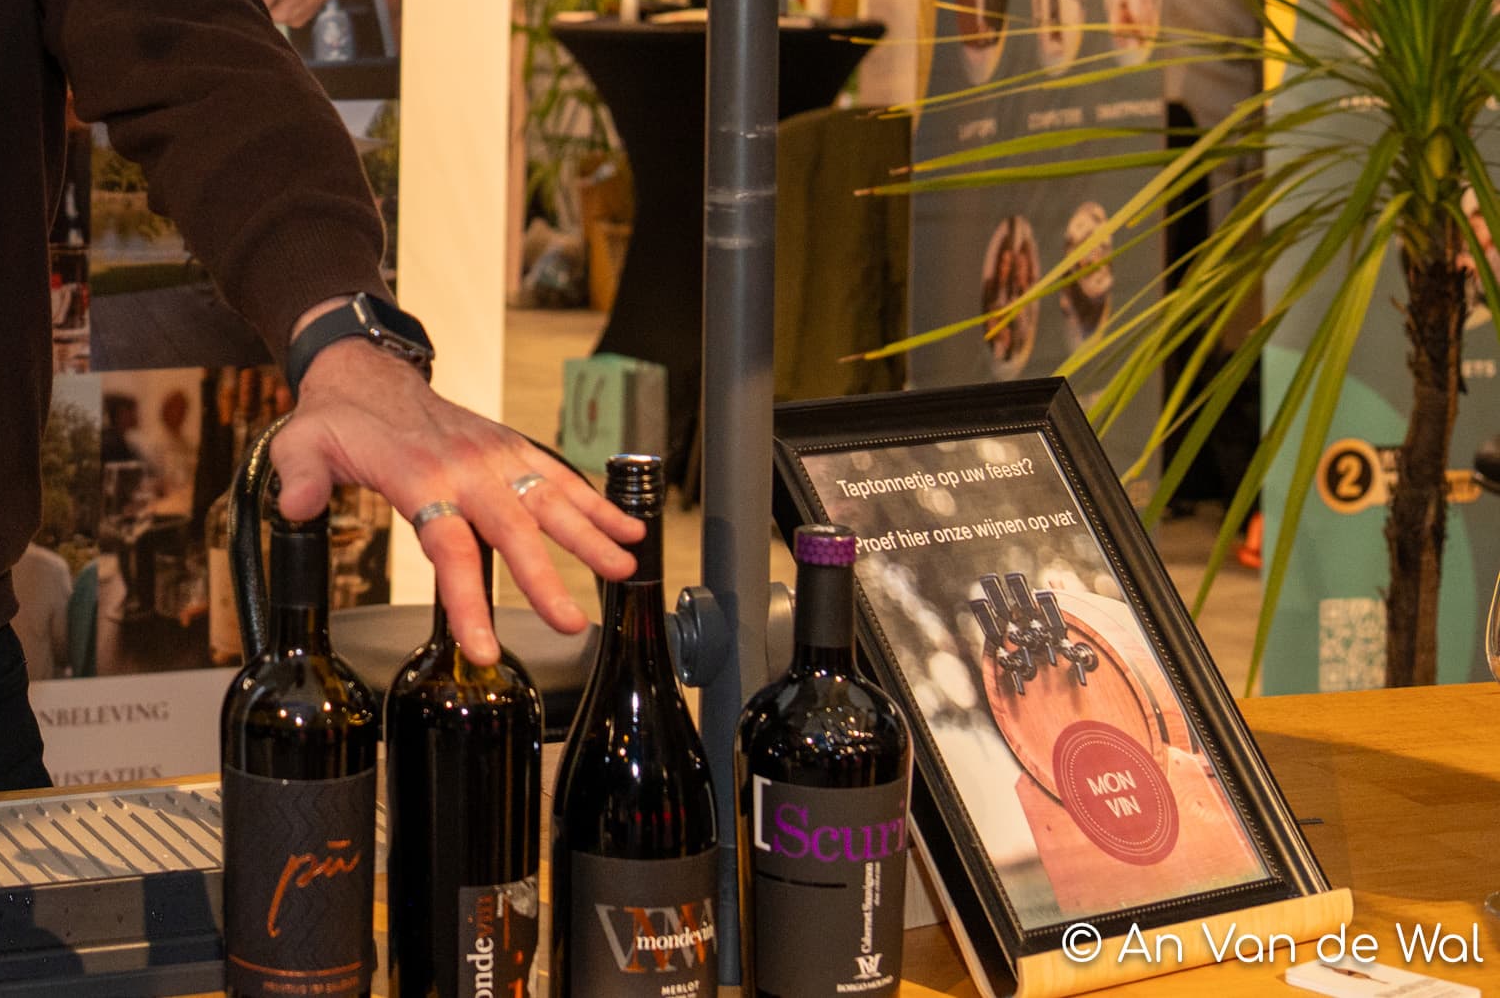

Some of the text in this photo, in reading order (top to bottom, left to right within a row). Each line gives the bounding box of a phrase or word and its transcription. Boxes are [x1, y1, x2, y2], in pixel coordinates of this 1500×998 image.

[836, 457, 1035, 500] Taptonnetje op uw feest?
[1335, 456, 1363, 498] 2
[896, 529, 931, 549] hier
[933, 524, 973, 543] onze
[972, 517, 1027, 540] wijnen
[1027, 514, 1050, 532] op
[1049, 509, 1077, 528] vat
[1086, 769, 1137, 797] MON
[1104, 794, 1142, 818] VIN
